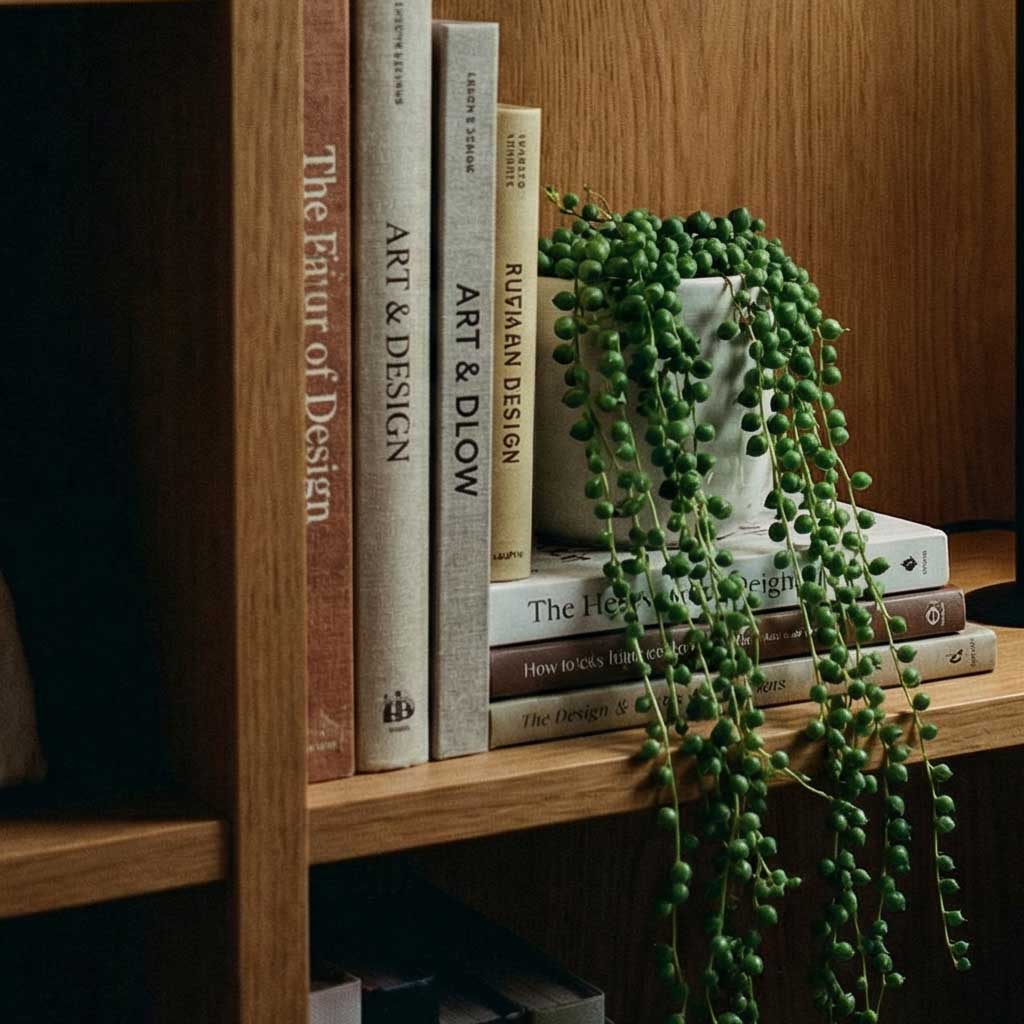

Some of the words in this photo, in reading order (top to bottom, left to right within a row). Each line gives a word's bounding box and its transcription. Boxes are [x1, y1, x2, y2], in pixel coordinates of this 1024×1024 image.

[303, 145, 337, 222] The
[386, 222, 411, 290] ART
[386, 301, 410, 326] &
[456, 283, 480, 349] ART
[305, 342, 338, 382] of
[455, 361, 480, 383] &
[386, 335, 410, 463] DESIGN
[502, 377, 522, 464] DESIGN
[305, 393, 338, 523] Design
[454, 395, 480, 497] DLOW
[527, 598, 575, 623] The
[523, 660, 558, 679] How
[521, 711, 550, 729] The
[554, 703, 609, 724] Design
[614, 698, 629, 717] &
